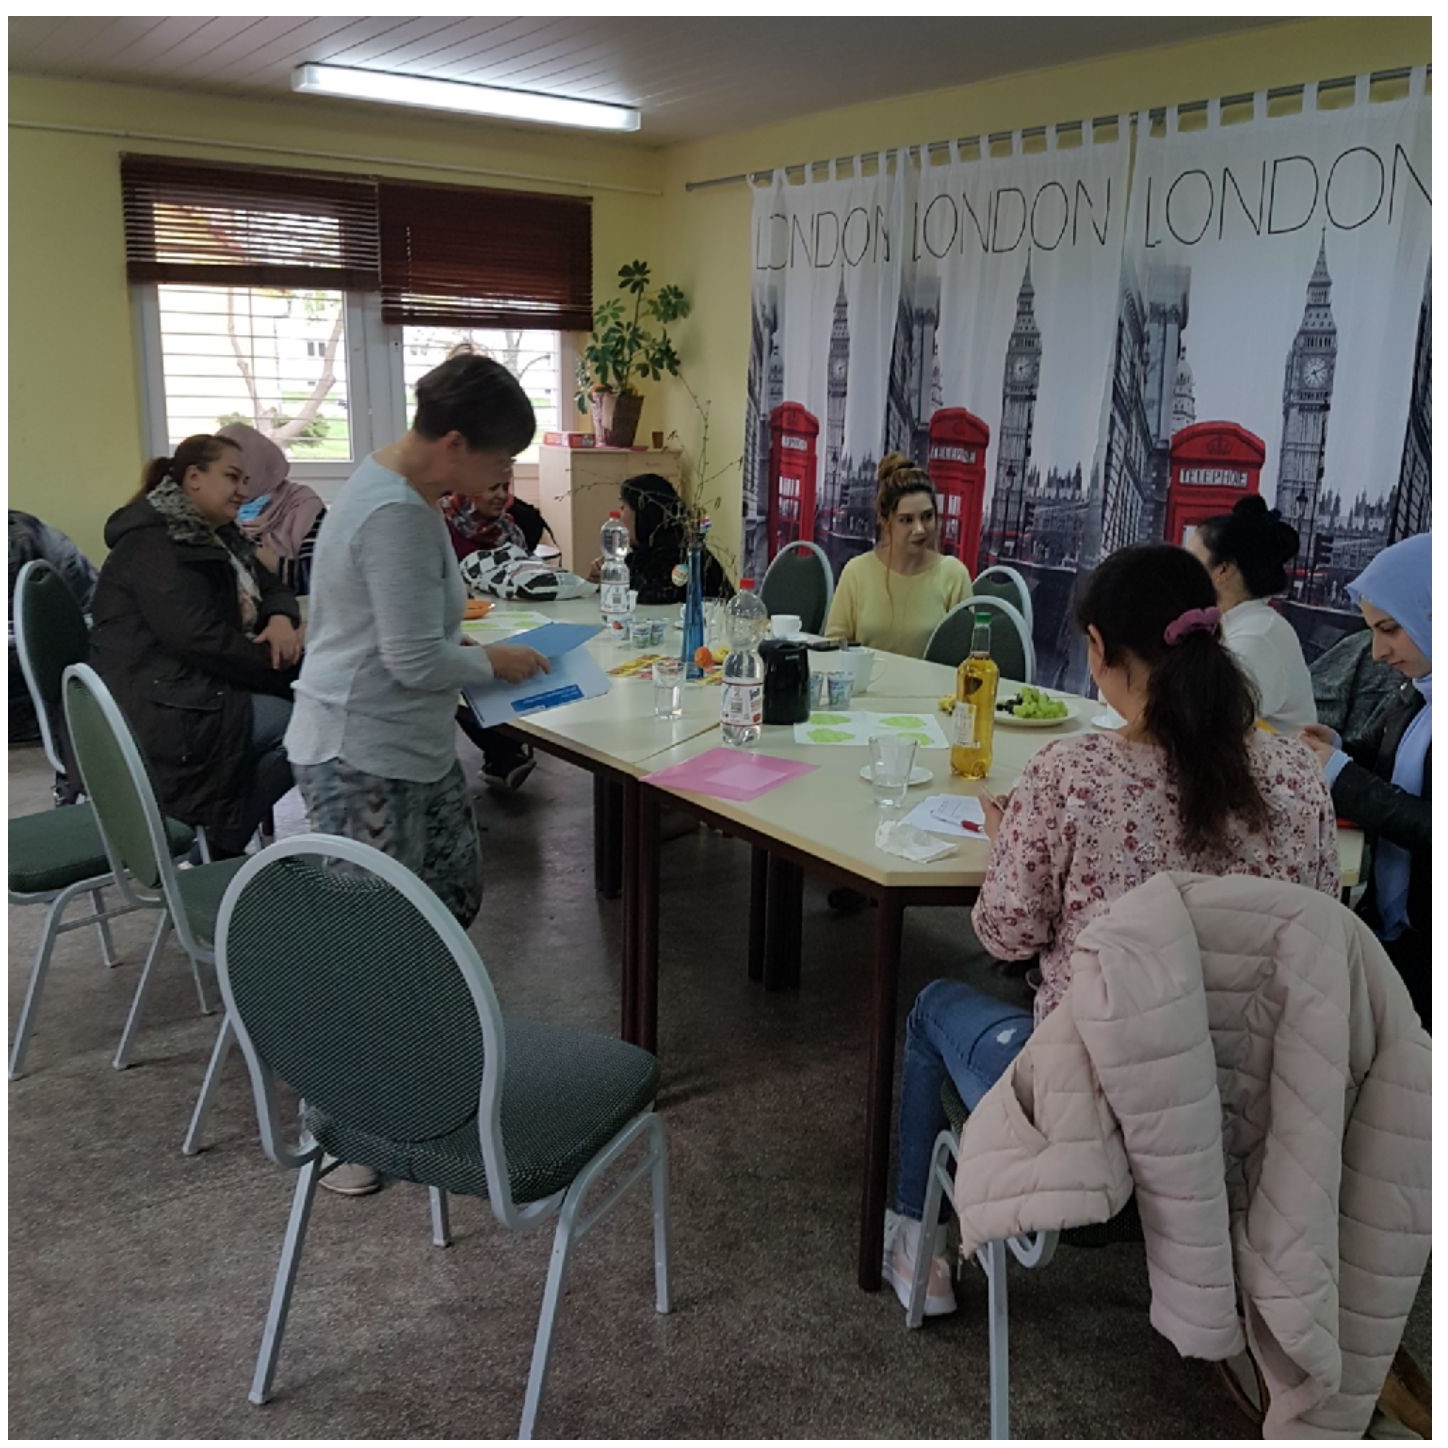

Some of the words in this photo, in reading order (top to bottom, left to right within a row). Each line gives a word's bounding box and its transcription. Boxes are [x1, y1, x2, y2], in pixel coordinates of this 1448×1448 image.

[756, 204, 890, 270] LONDON
[912, 176, 1110, 263] LONDON
[1145, 143, 1431, 247] LONDON
